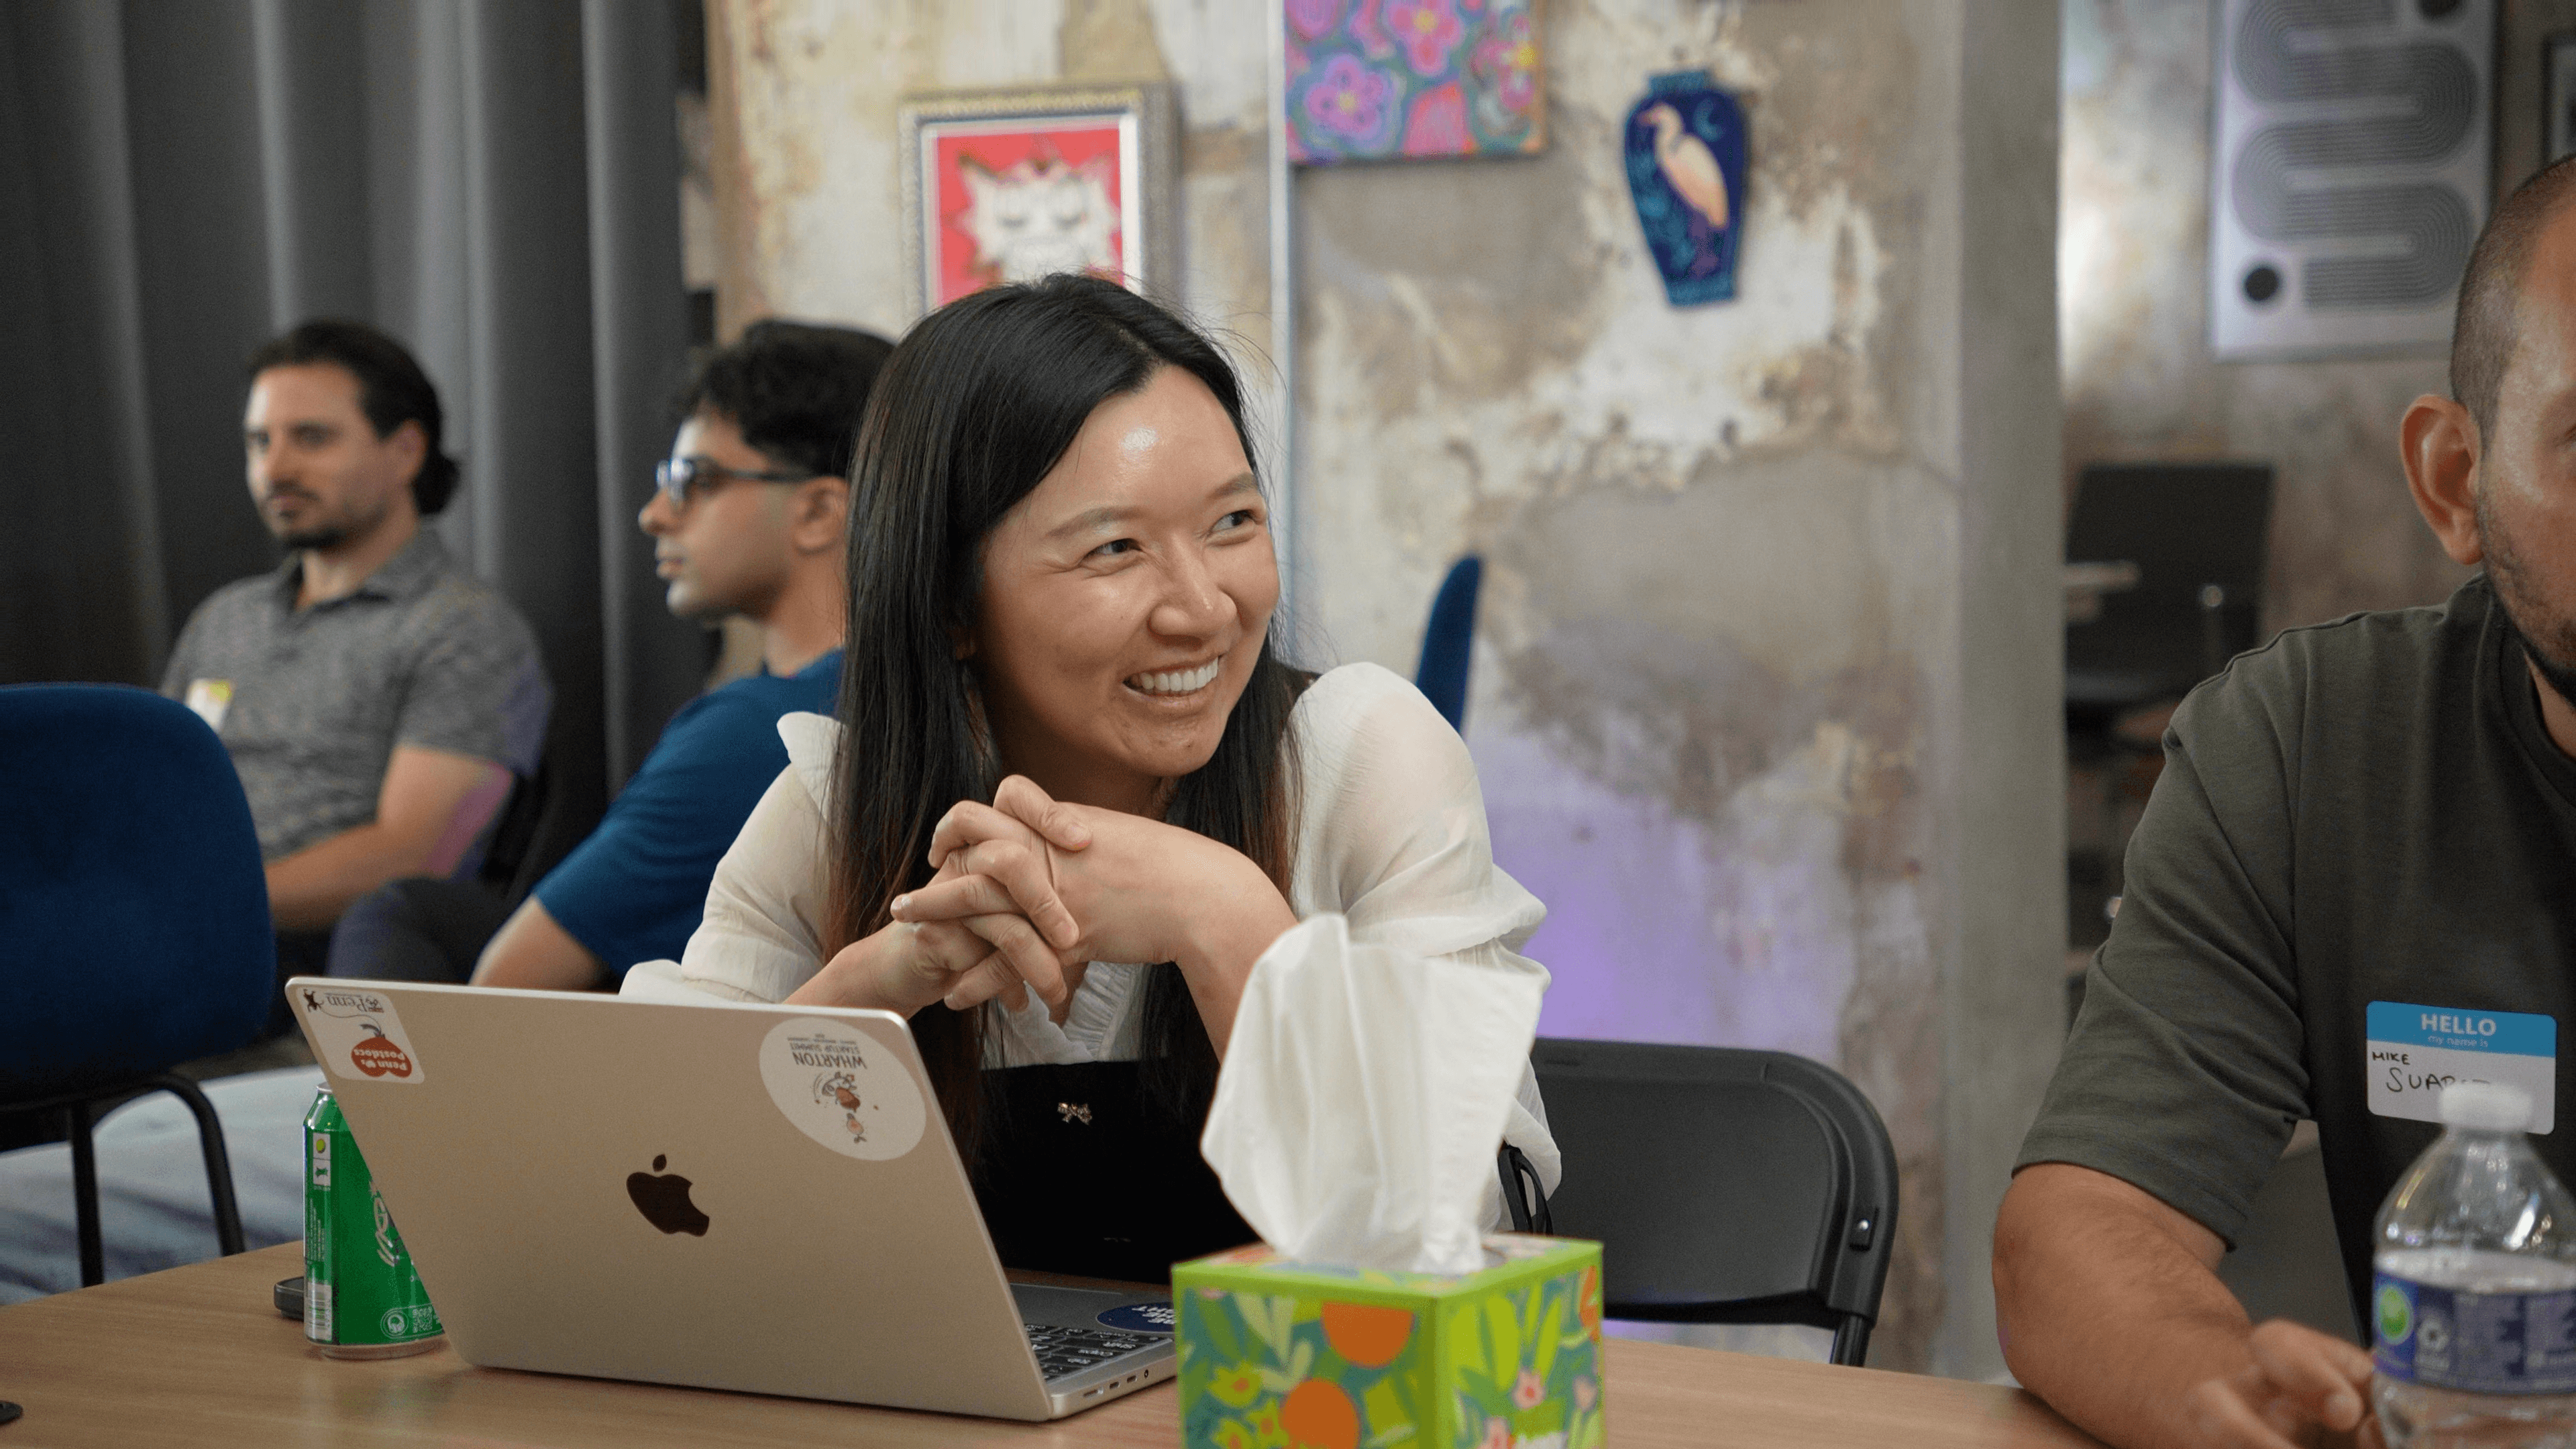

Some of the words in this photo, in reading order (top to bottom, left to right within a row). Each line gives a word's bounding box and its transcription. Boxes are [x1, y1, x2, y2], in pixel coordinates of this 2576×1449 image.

[326, 996, 368, 1012] Penn
[2420, 1013, 2497, 1036] HELLO
[2428, 1035, 2444, 1045] my
[353, 1049, 406, 1061] Postdocs
[792, 1052, 868, 1069] WHARTON
[2371, 1051, 2411, 1065] MIKE
[377, 1059, 409, 1071] Penn
[2385, 1067, 2491, 1093] SUA
